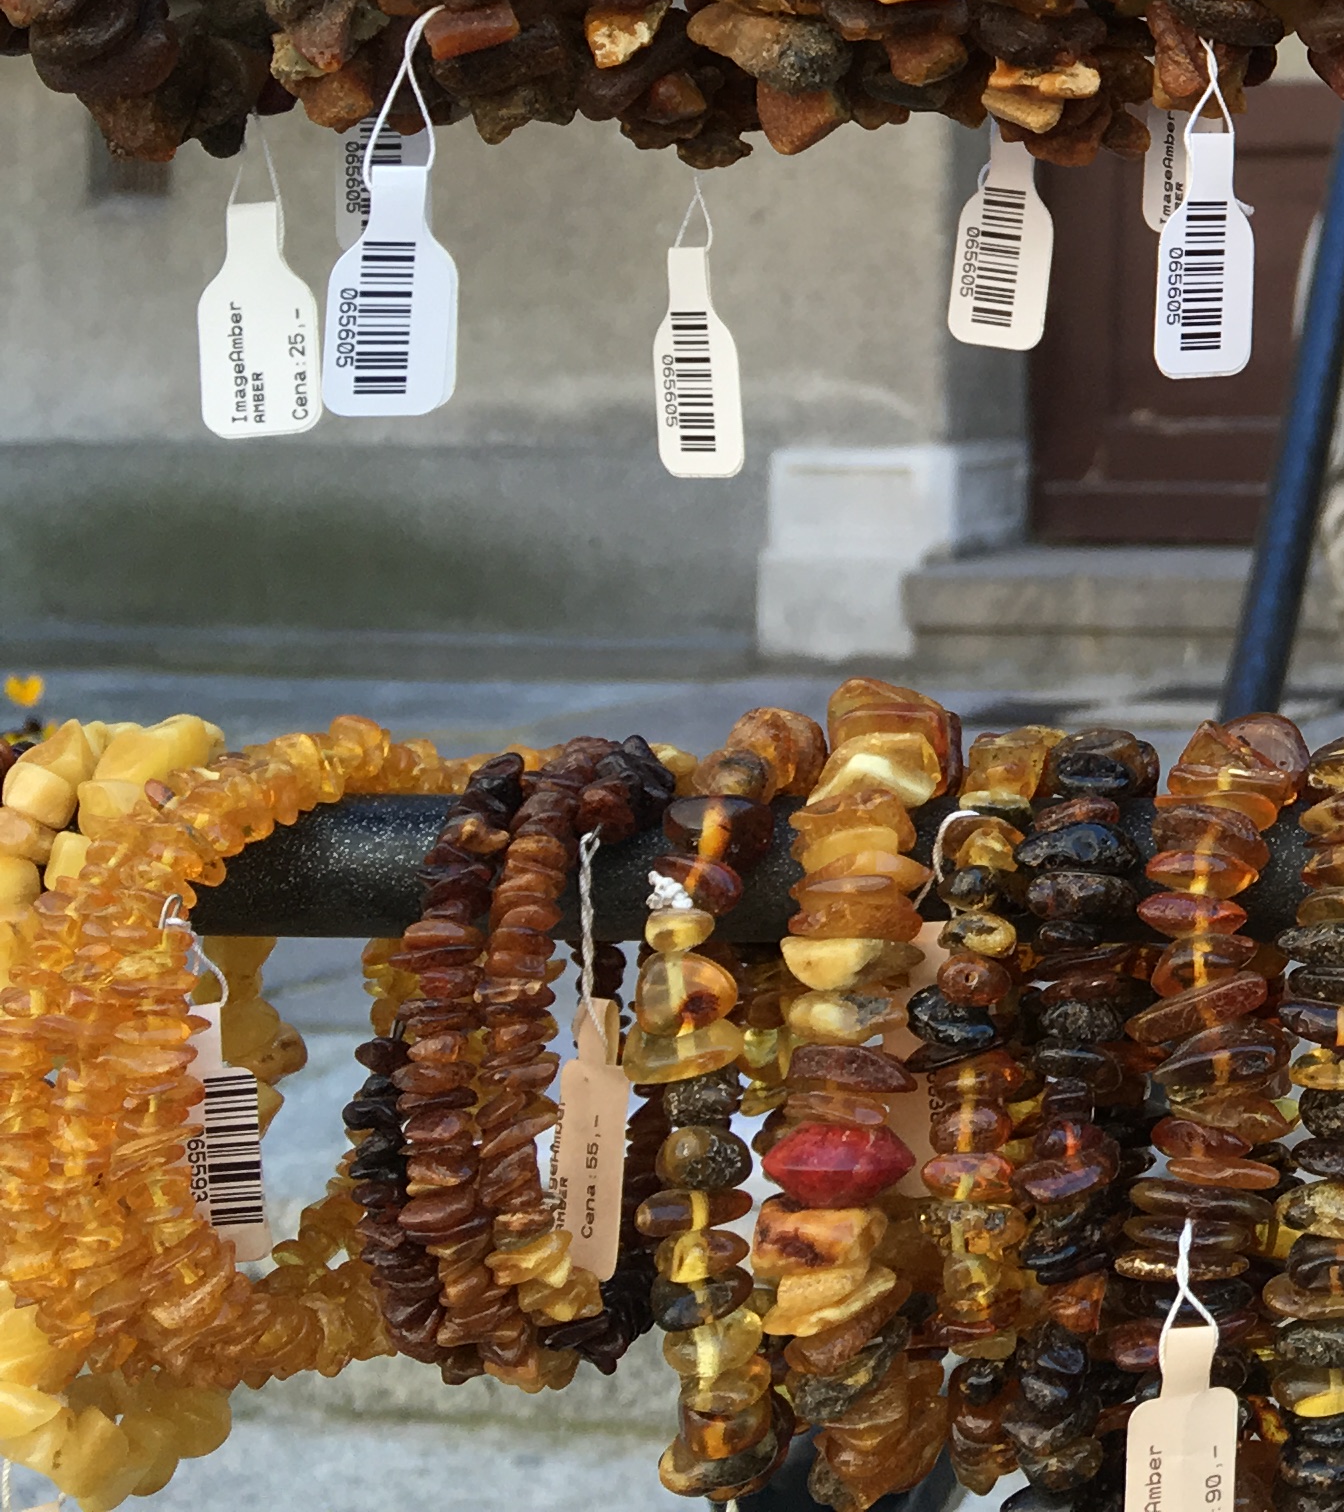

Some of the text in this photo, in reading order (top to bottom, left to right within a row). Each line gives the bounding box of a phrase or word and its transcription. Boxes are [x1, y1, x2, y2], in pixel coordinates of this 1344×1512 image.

[345, 141, 361, 214] 065605
[959, 225, 979, 298] 065605
[1166, 246, 1183, 325] 065605
[229, 301, 247, 424] ImageAmber
[336, 287, 359, 369] 065605
[252, 371, 266, 424] AMBER
[661, 354, 679, 428] 065605
